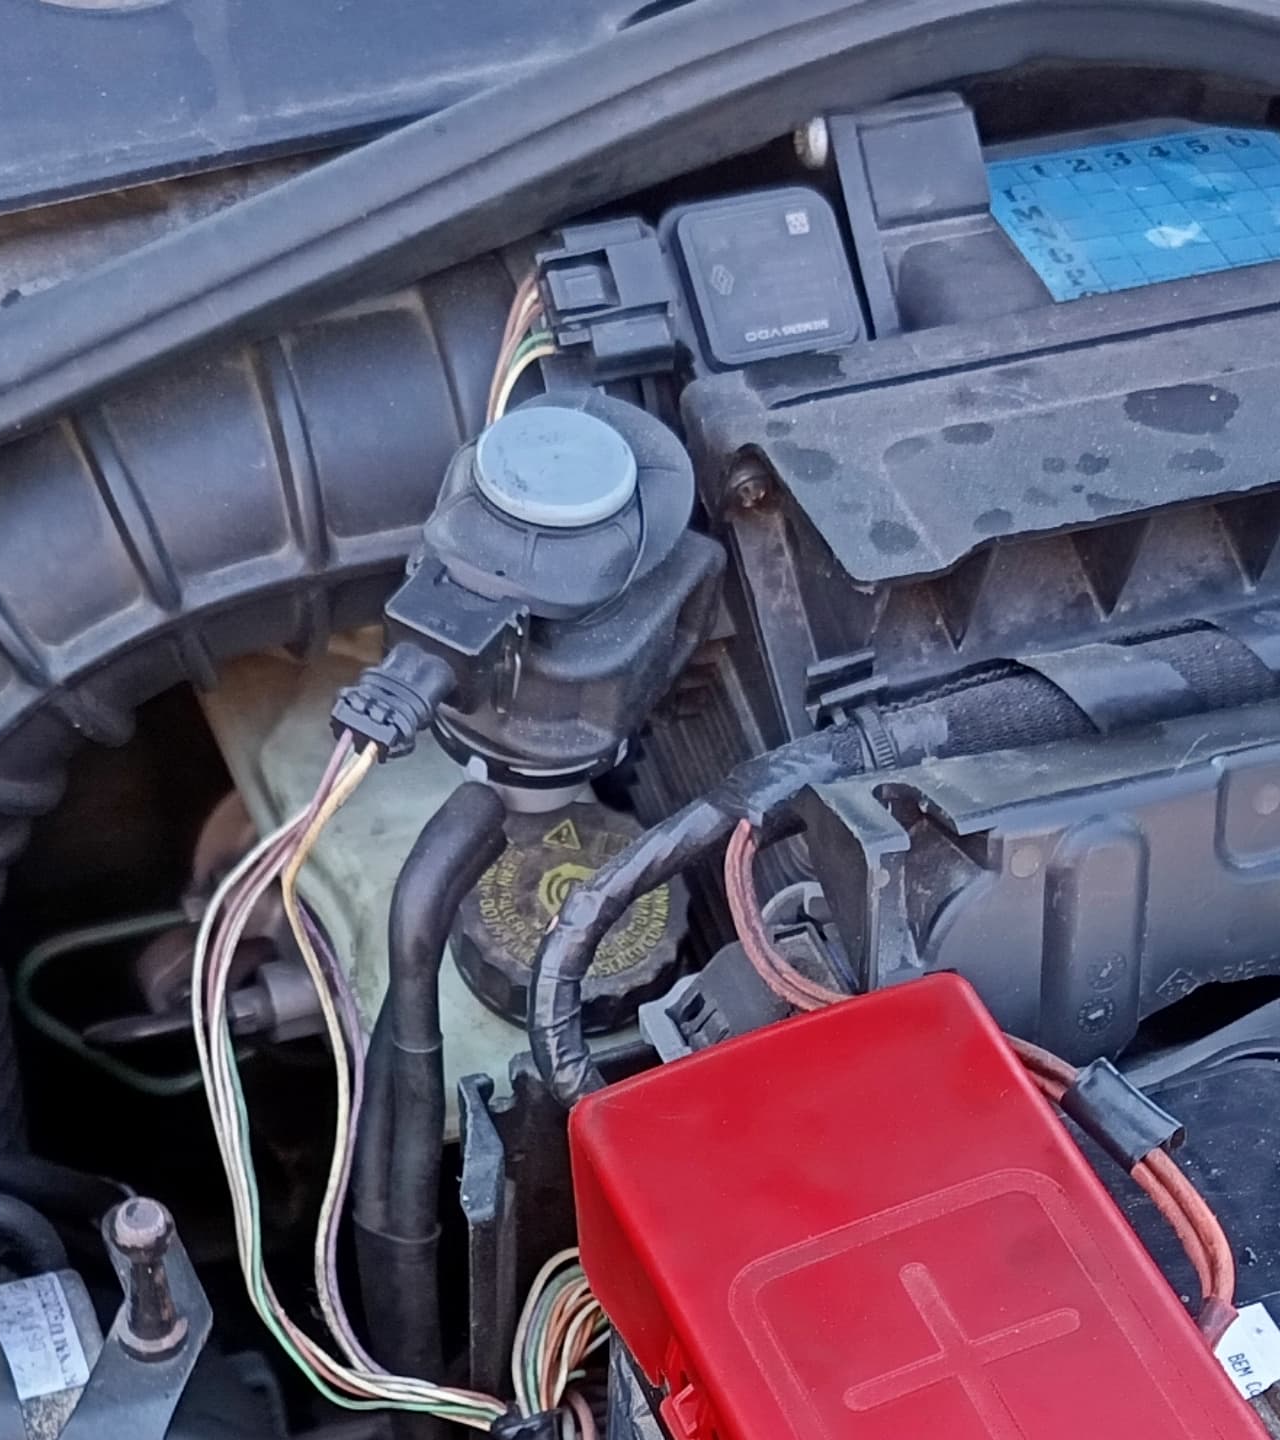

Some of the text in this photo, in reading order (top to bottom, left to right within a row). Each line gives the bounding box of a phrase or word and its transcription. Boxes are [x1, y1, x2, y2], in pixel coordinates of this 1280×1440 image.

[1030, 134, 1251, 179] 1 2 3 4 5 6
[744, 327, 781, 343] VDO
[1227, 1352, 1255, 1378] BEM
